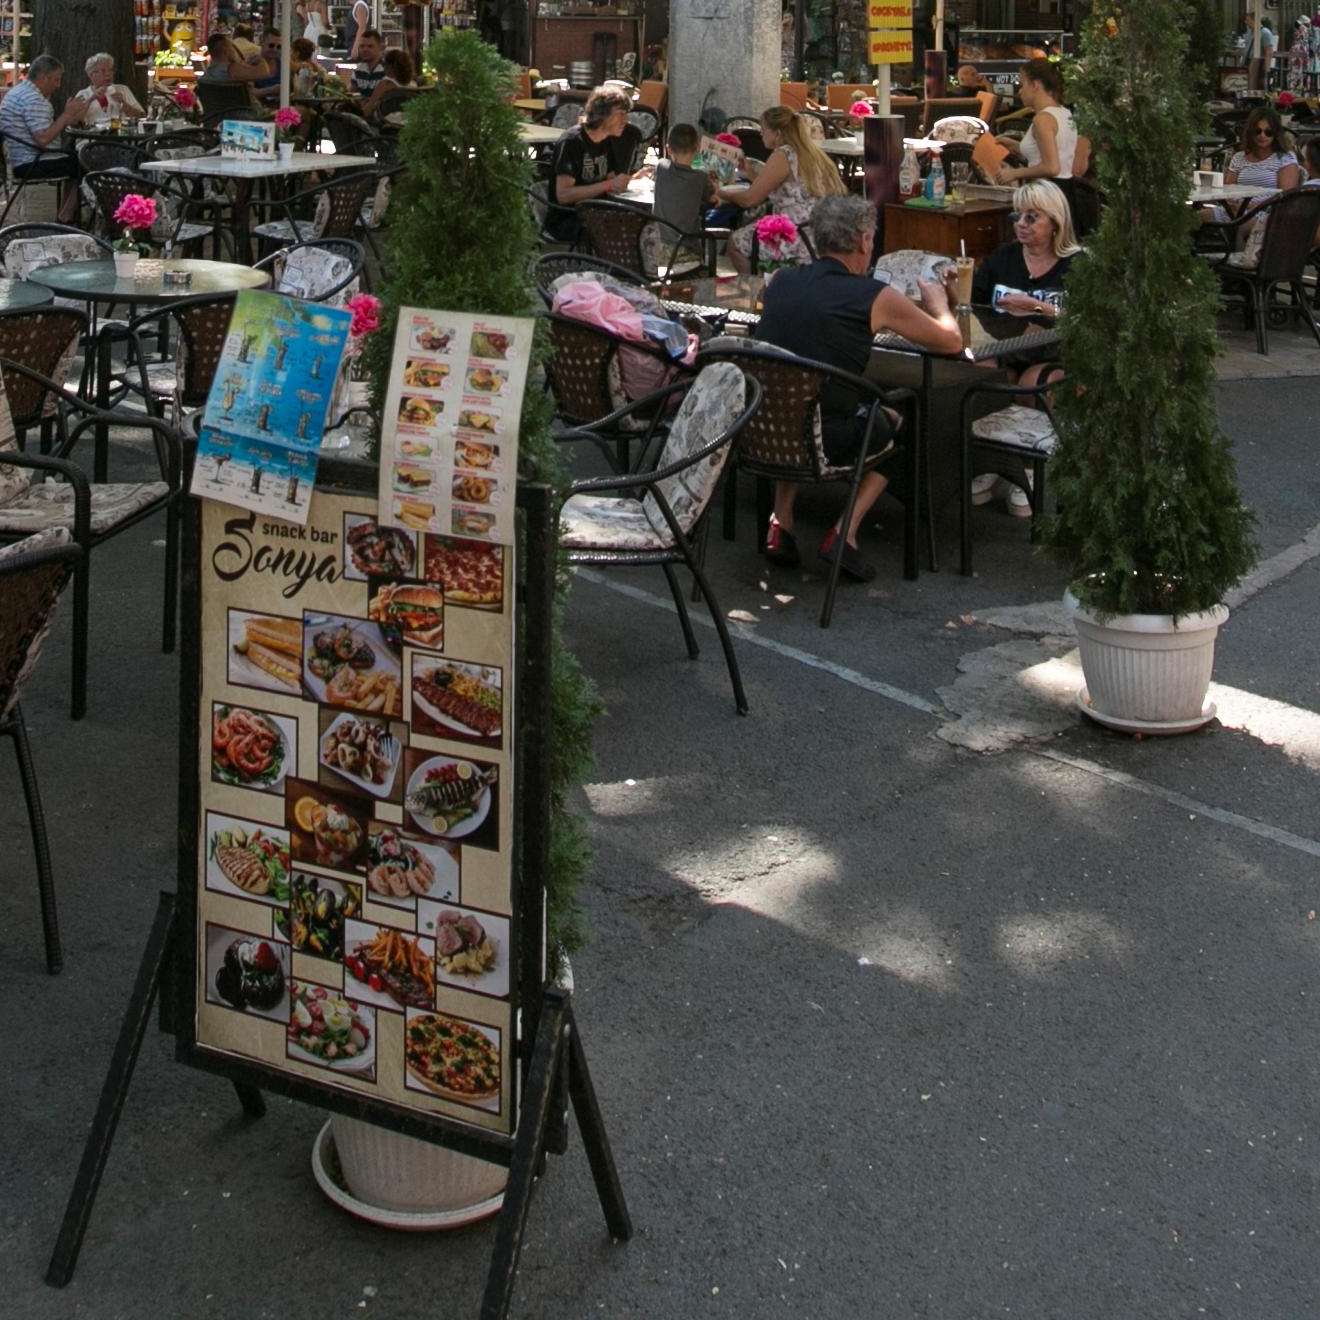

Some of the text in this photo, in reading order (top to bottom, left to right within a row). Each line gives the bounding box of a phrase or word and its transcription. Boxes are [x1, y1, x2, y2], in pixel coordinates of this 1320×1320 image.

[212, 511, 346, 599] Sonya
[262, 522, 338, 544] snack bar
